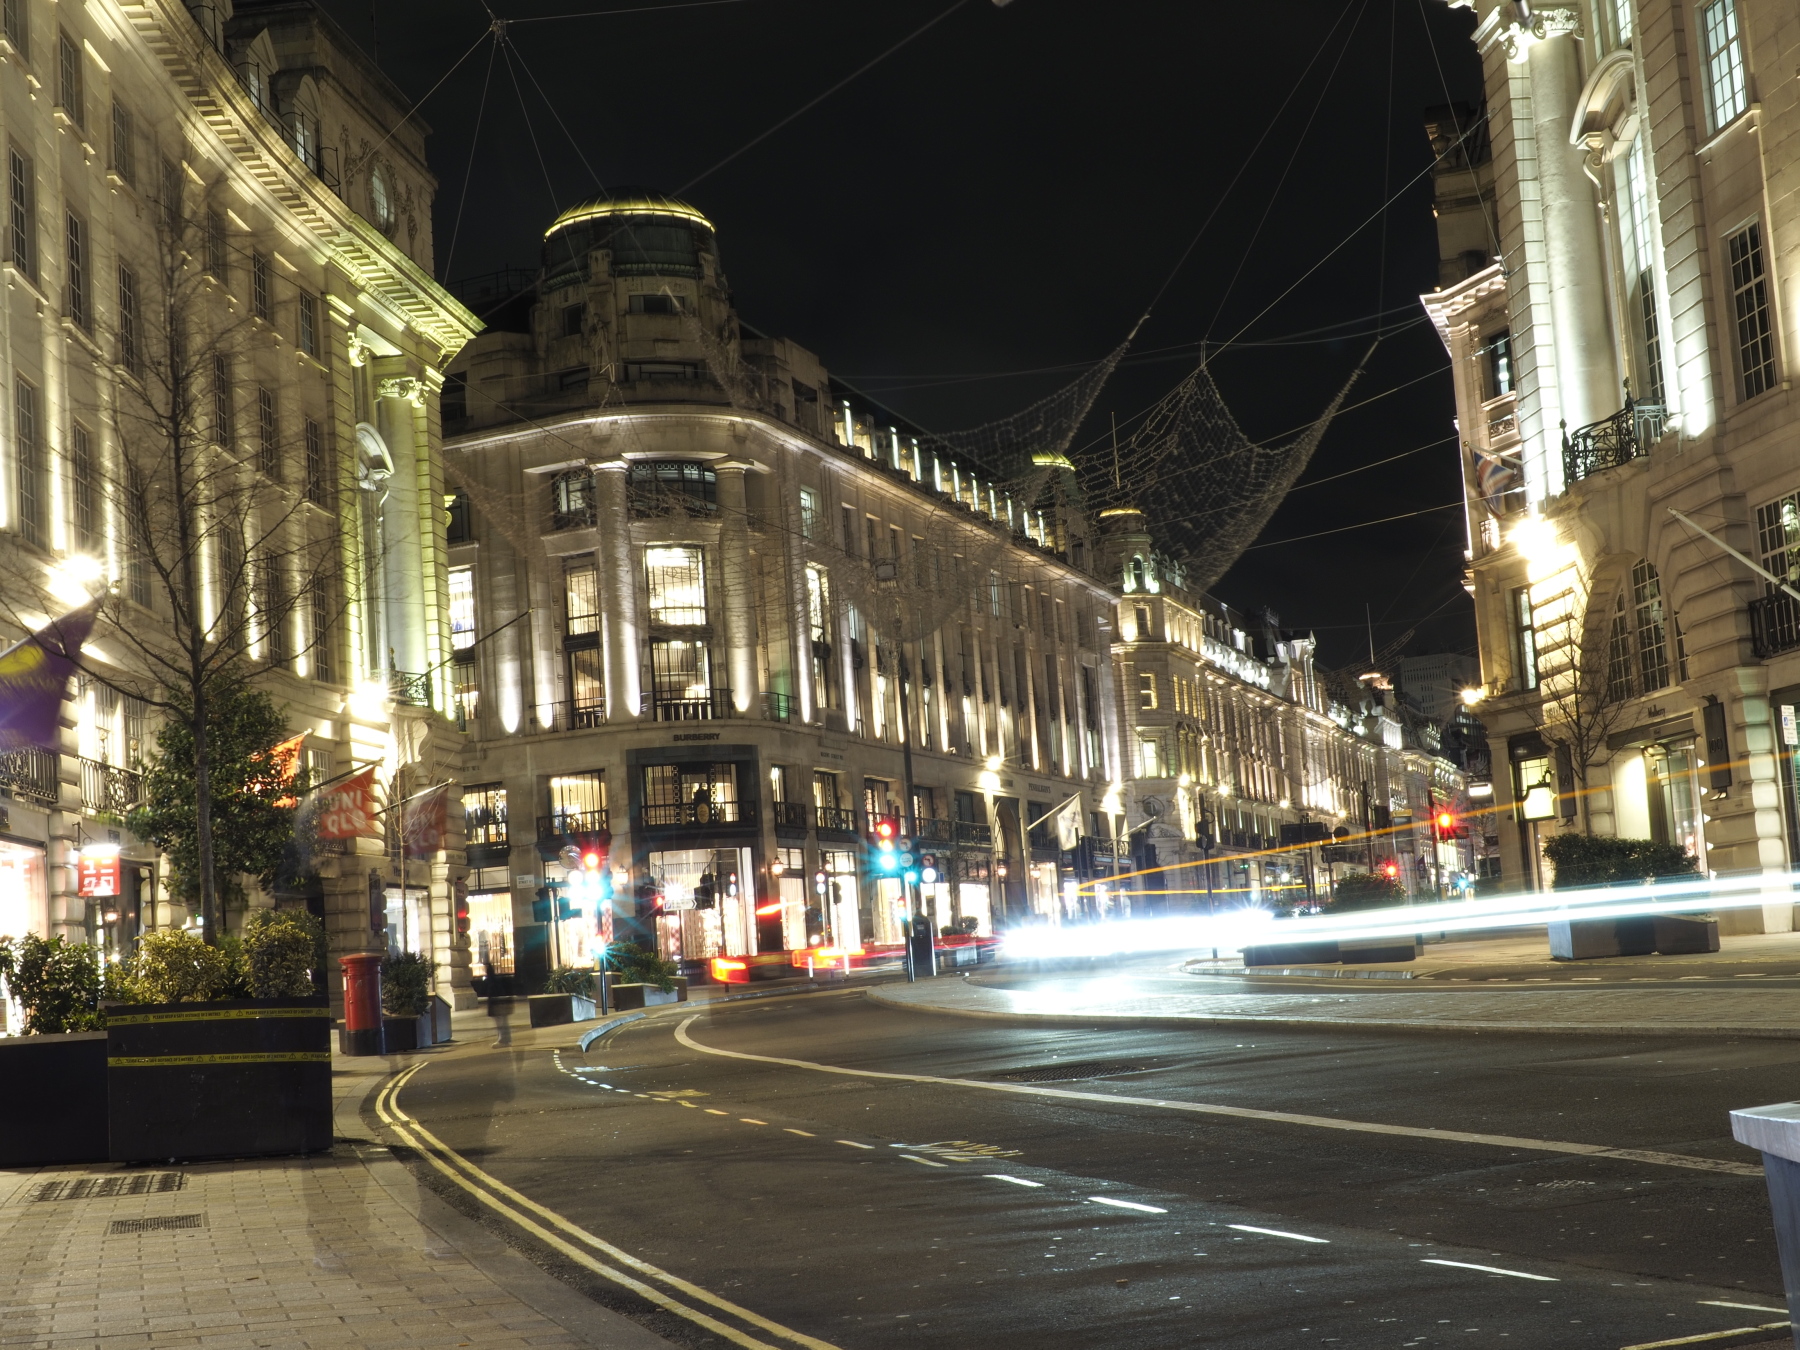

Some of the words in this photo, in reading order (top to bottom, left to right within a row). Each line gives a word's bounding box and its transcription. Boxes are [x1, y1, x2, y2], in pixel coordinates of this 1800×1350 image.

[673, 733, 720, 741] BURBERRY
[327, 808, 367, 835] QLO
[83, 859, 114, 874] ユニ
